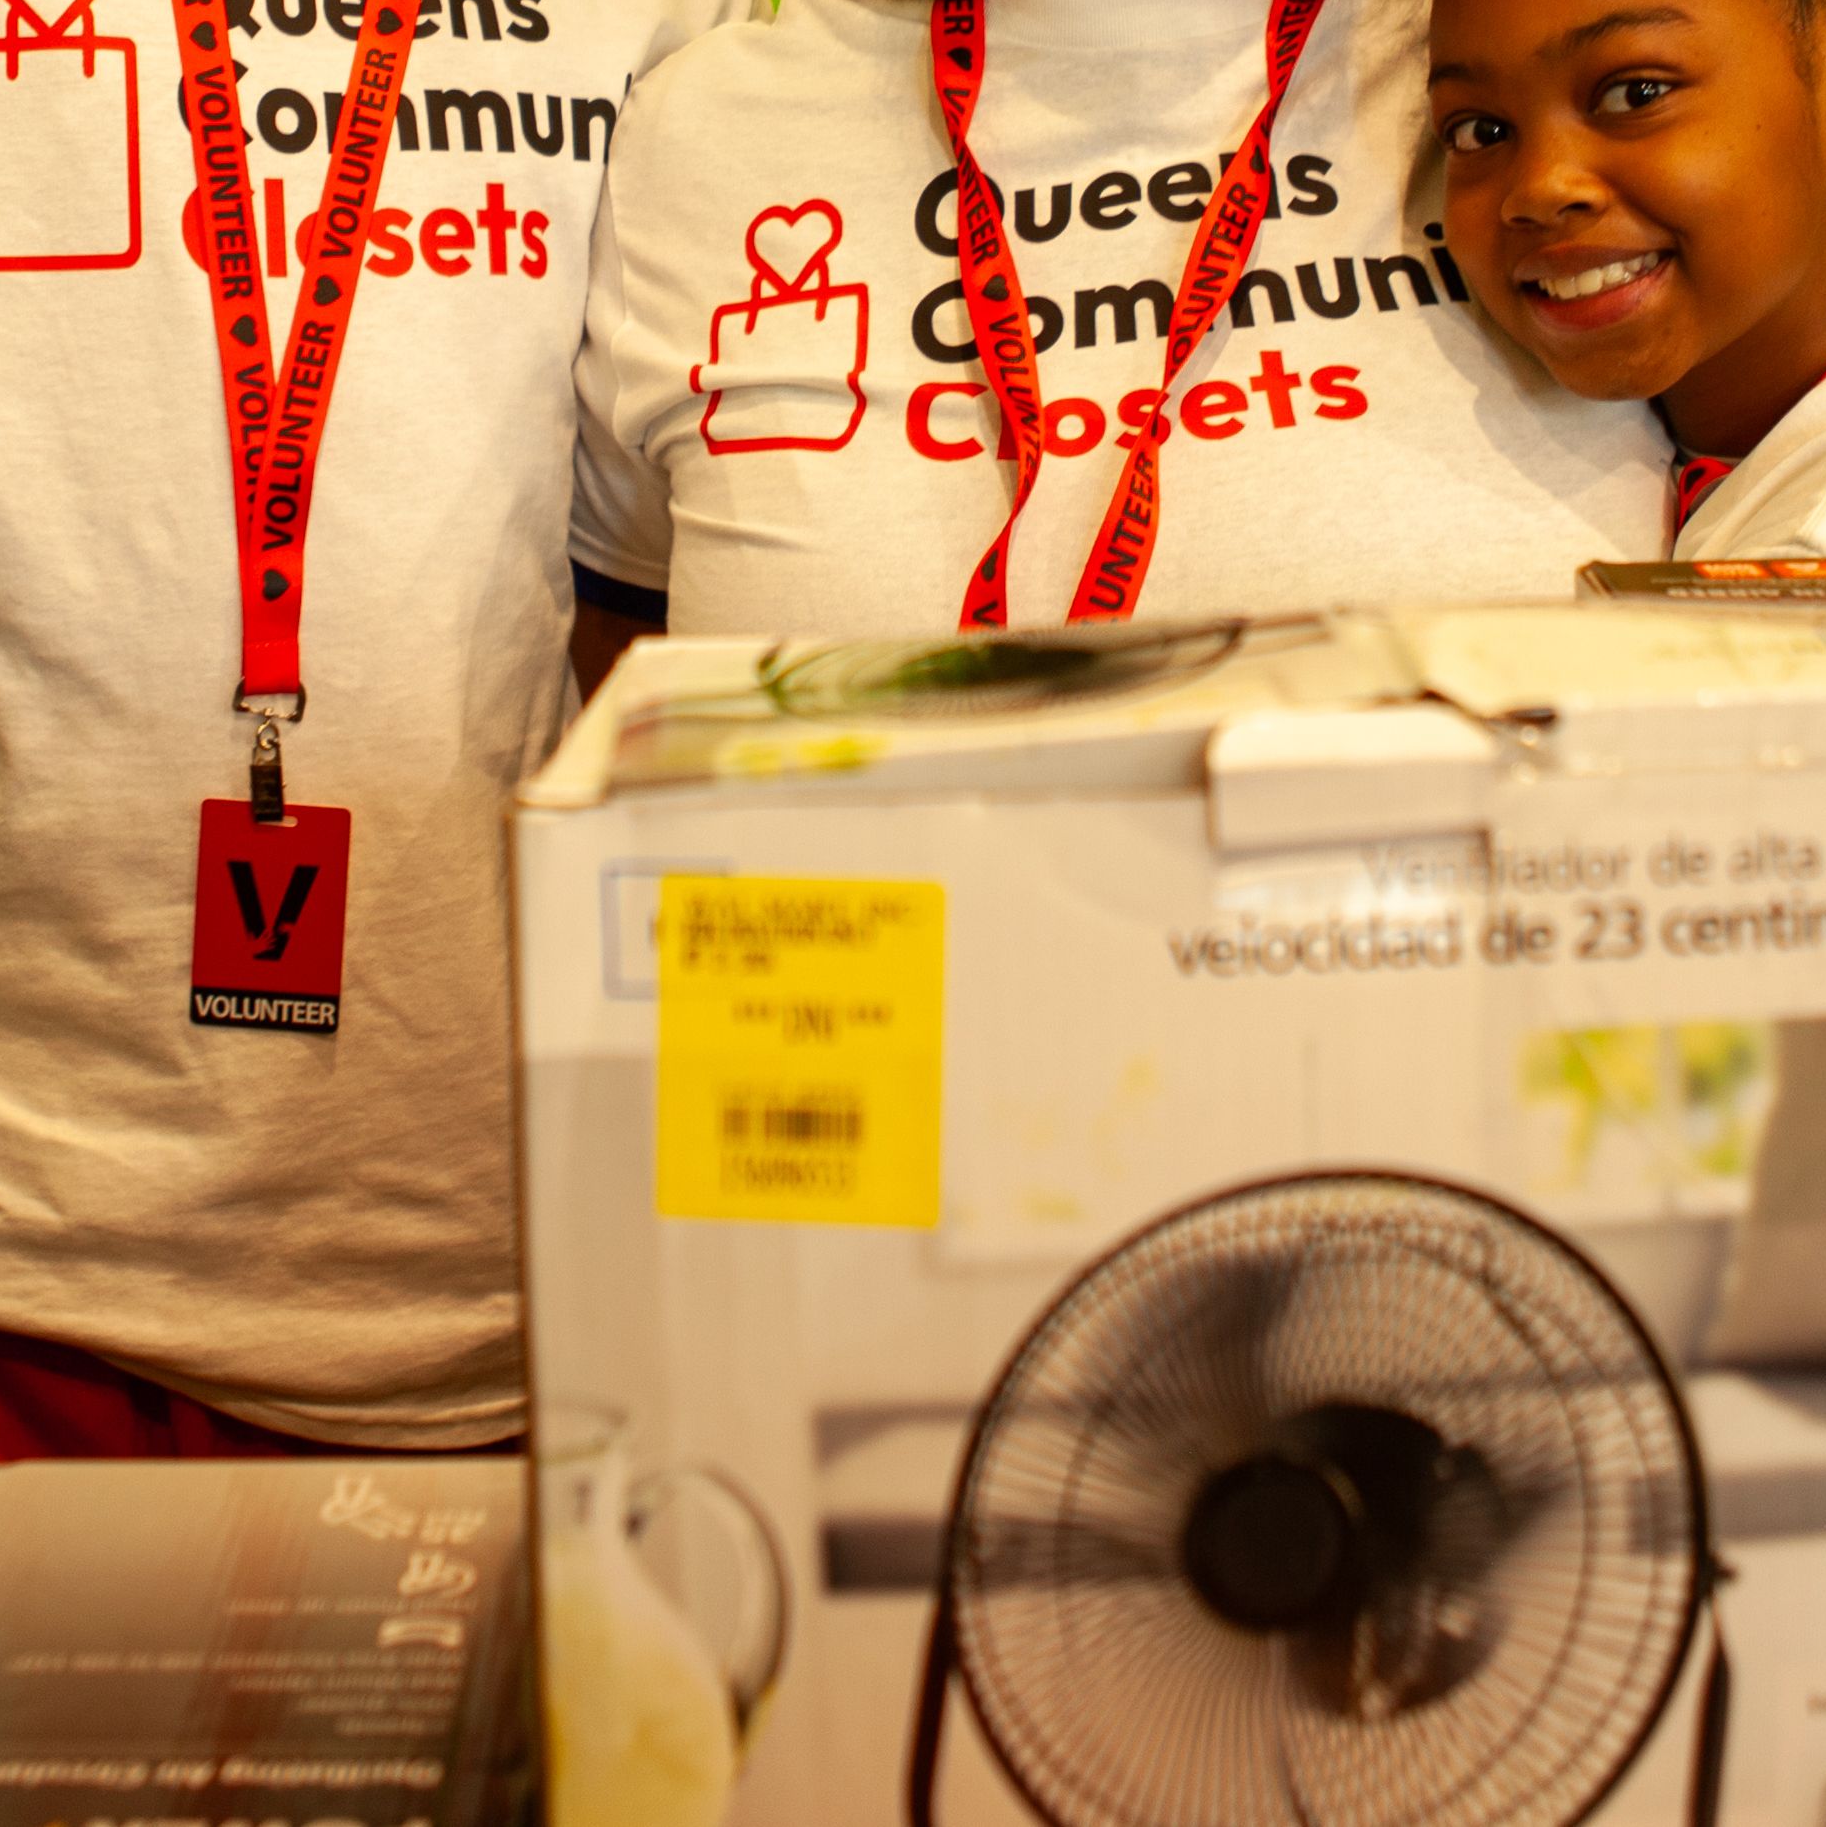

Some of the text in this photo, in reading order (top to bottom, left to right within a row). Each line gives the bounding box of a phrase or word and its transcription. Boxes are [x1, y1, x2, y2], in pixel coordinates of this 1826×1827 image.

[194, 65, 256, 302] VOLUNTEER
[317, 45, 399, 261] VOLUNTEER
[1172, 182, 1260, 374] OLUNTEER
[261, 319, 336, 553] VOLUNTEER
[1082, 450, 1155, 625] UNTEER
[1478, 903, 1555, 966] de
[1573, 900, 1647, 962] 23
[1647, 840, 1709, 889] de
[194, 992, 336, 1028] VOLUNTEER
